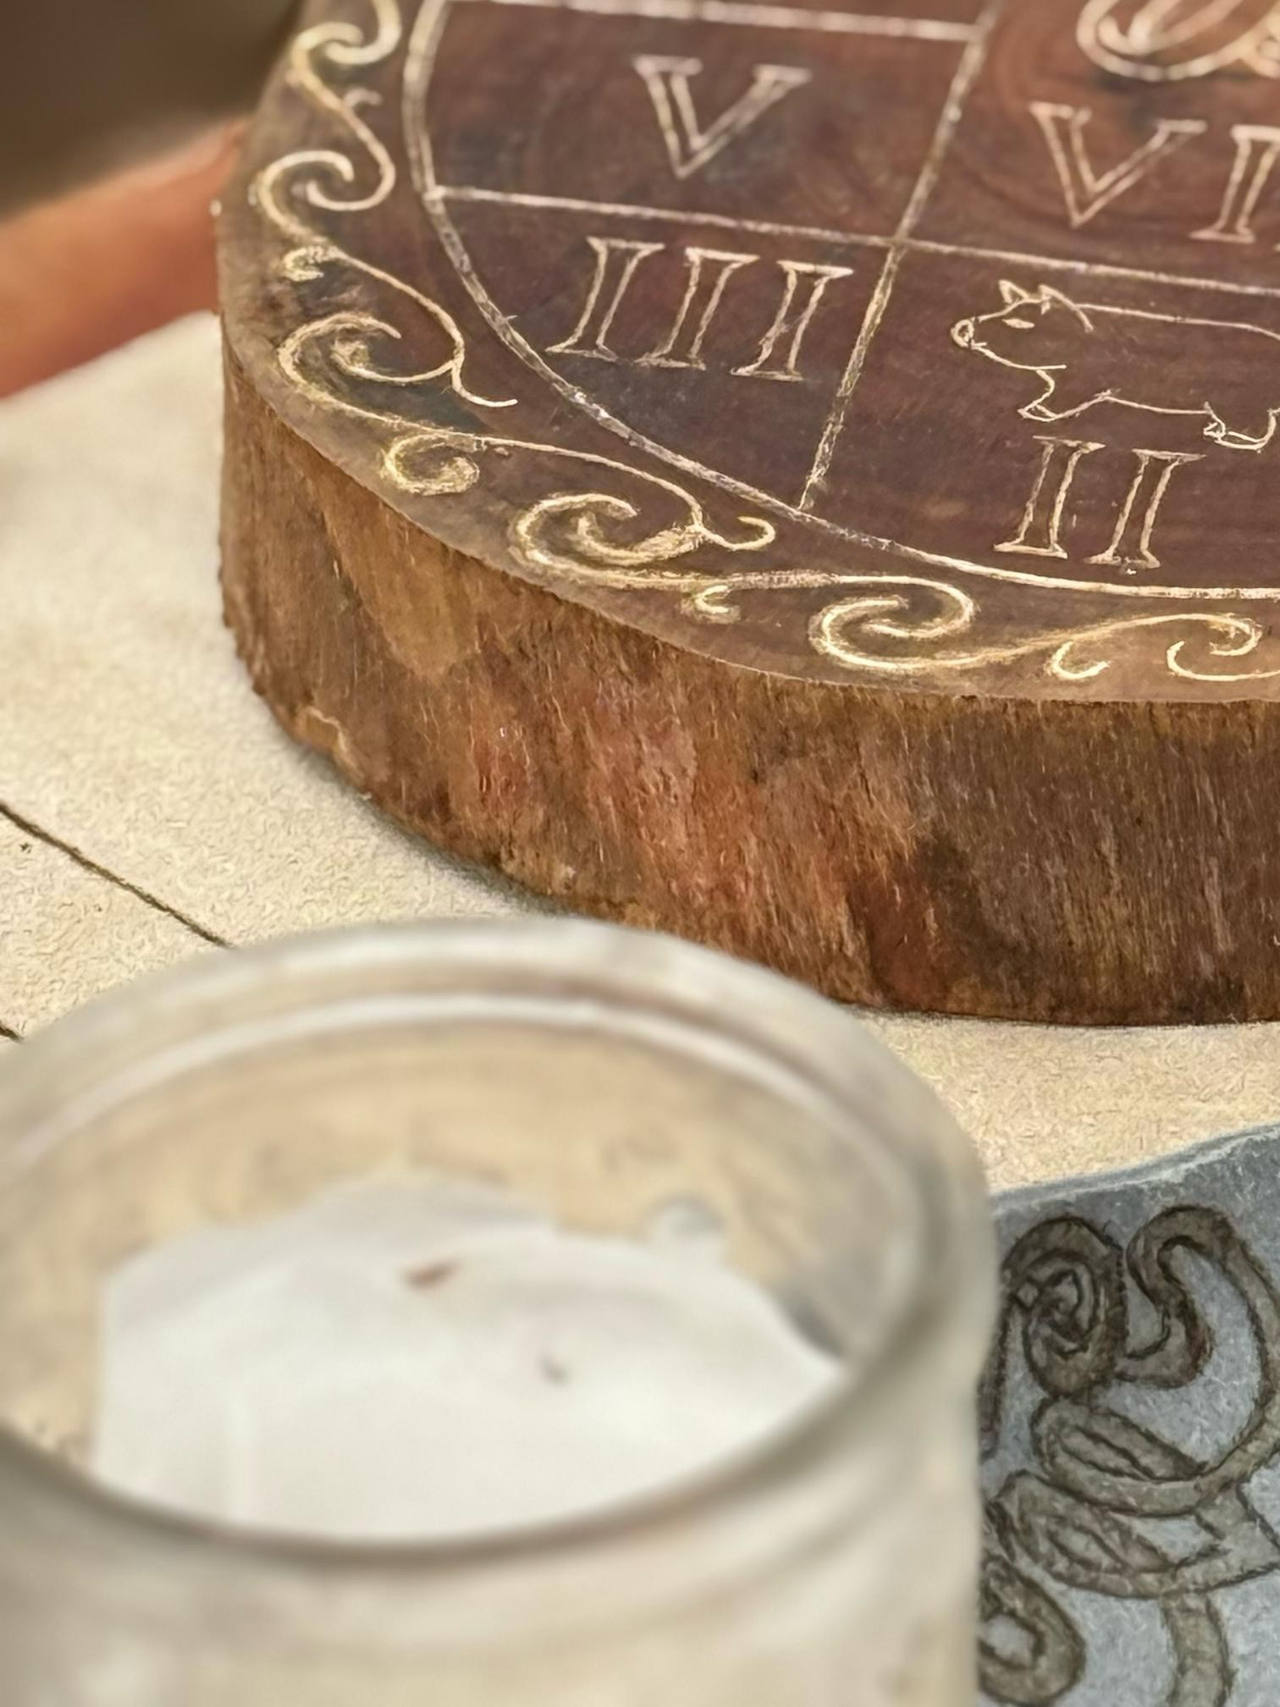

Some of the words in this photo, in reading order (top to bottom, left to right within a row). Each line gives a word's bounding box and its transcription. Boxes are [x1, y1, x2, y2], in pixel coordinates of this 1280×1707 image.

[632, 56, 811, 180] V
[545, 235, 854, 382] III
[993, 434, 1206, 569] II
